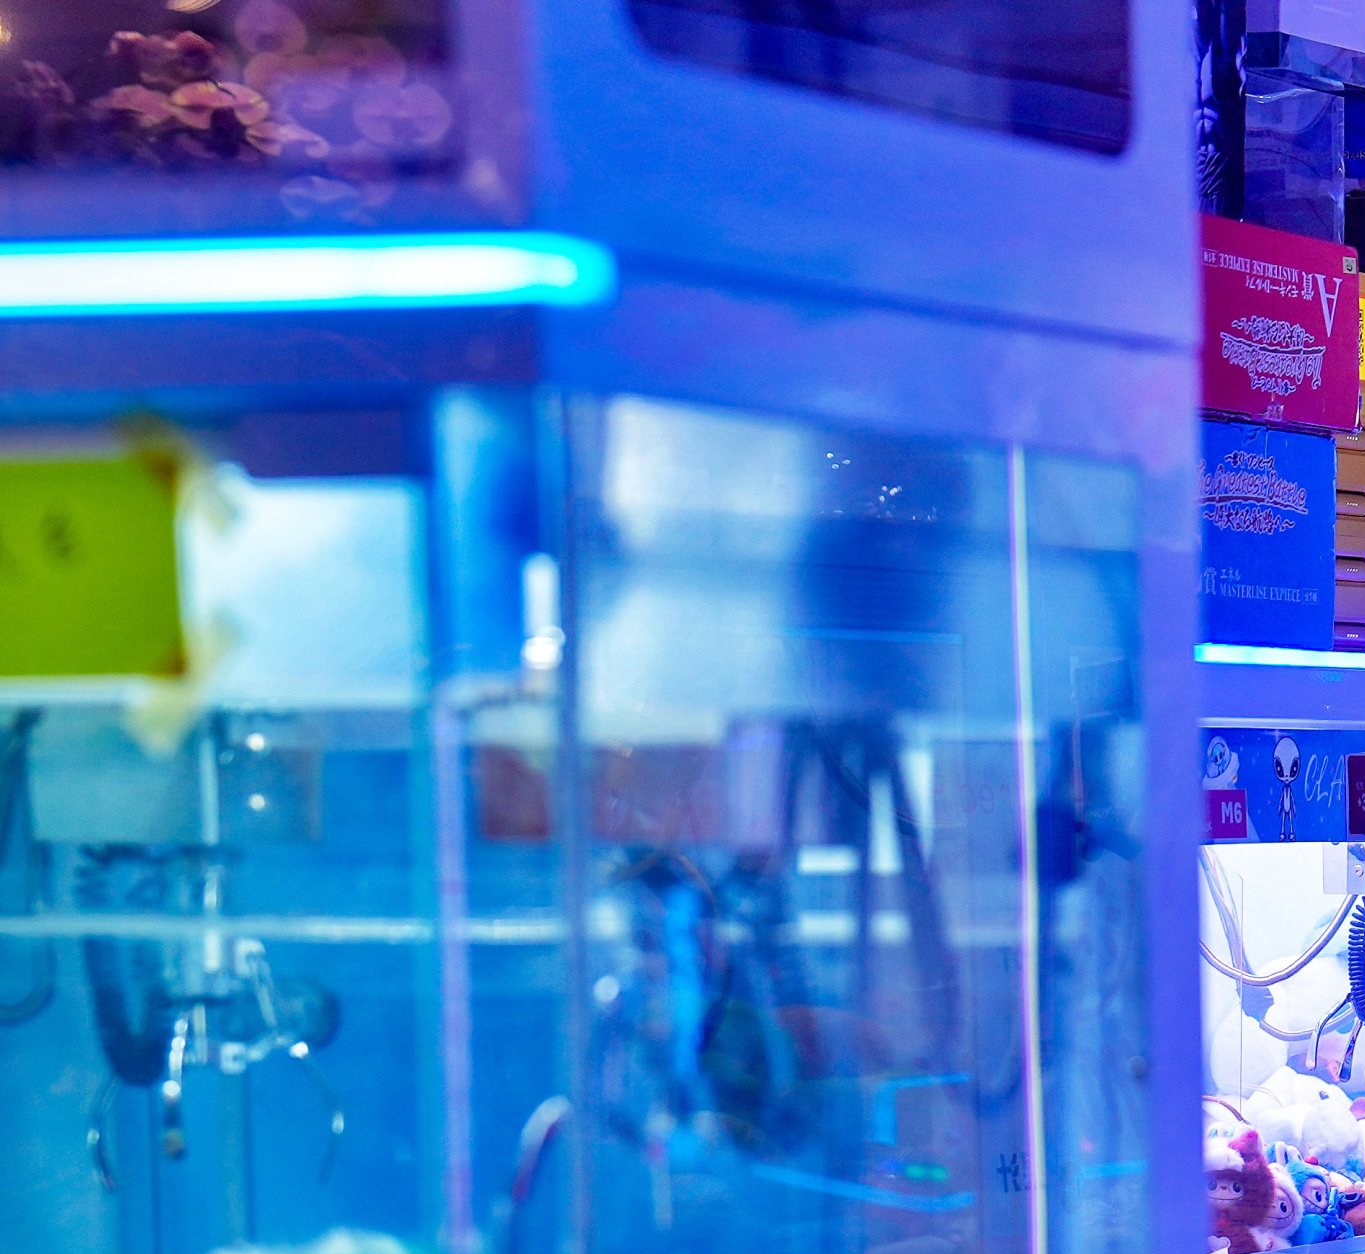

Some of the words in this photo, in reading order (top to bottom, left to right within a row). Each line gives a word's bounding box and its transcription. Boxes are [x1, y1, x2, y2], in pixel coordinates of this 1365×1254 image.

[1219, 252, 1251, 274] EXPIECE
[1252, 260, 1299, 283] MASTERLISE
[1219, 582, 1269, 601] MASTERLISE
[1269, 586, 1301, 603] EXPIECE
[1220, 801, 1243, 825] M6
